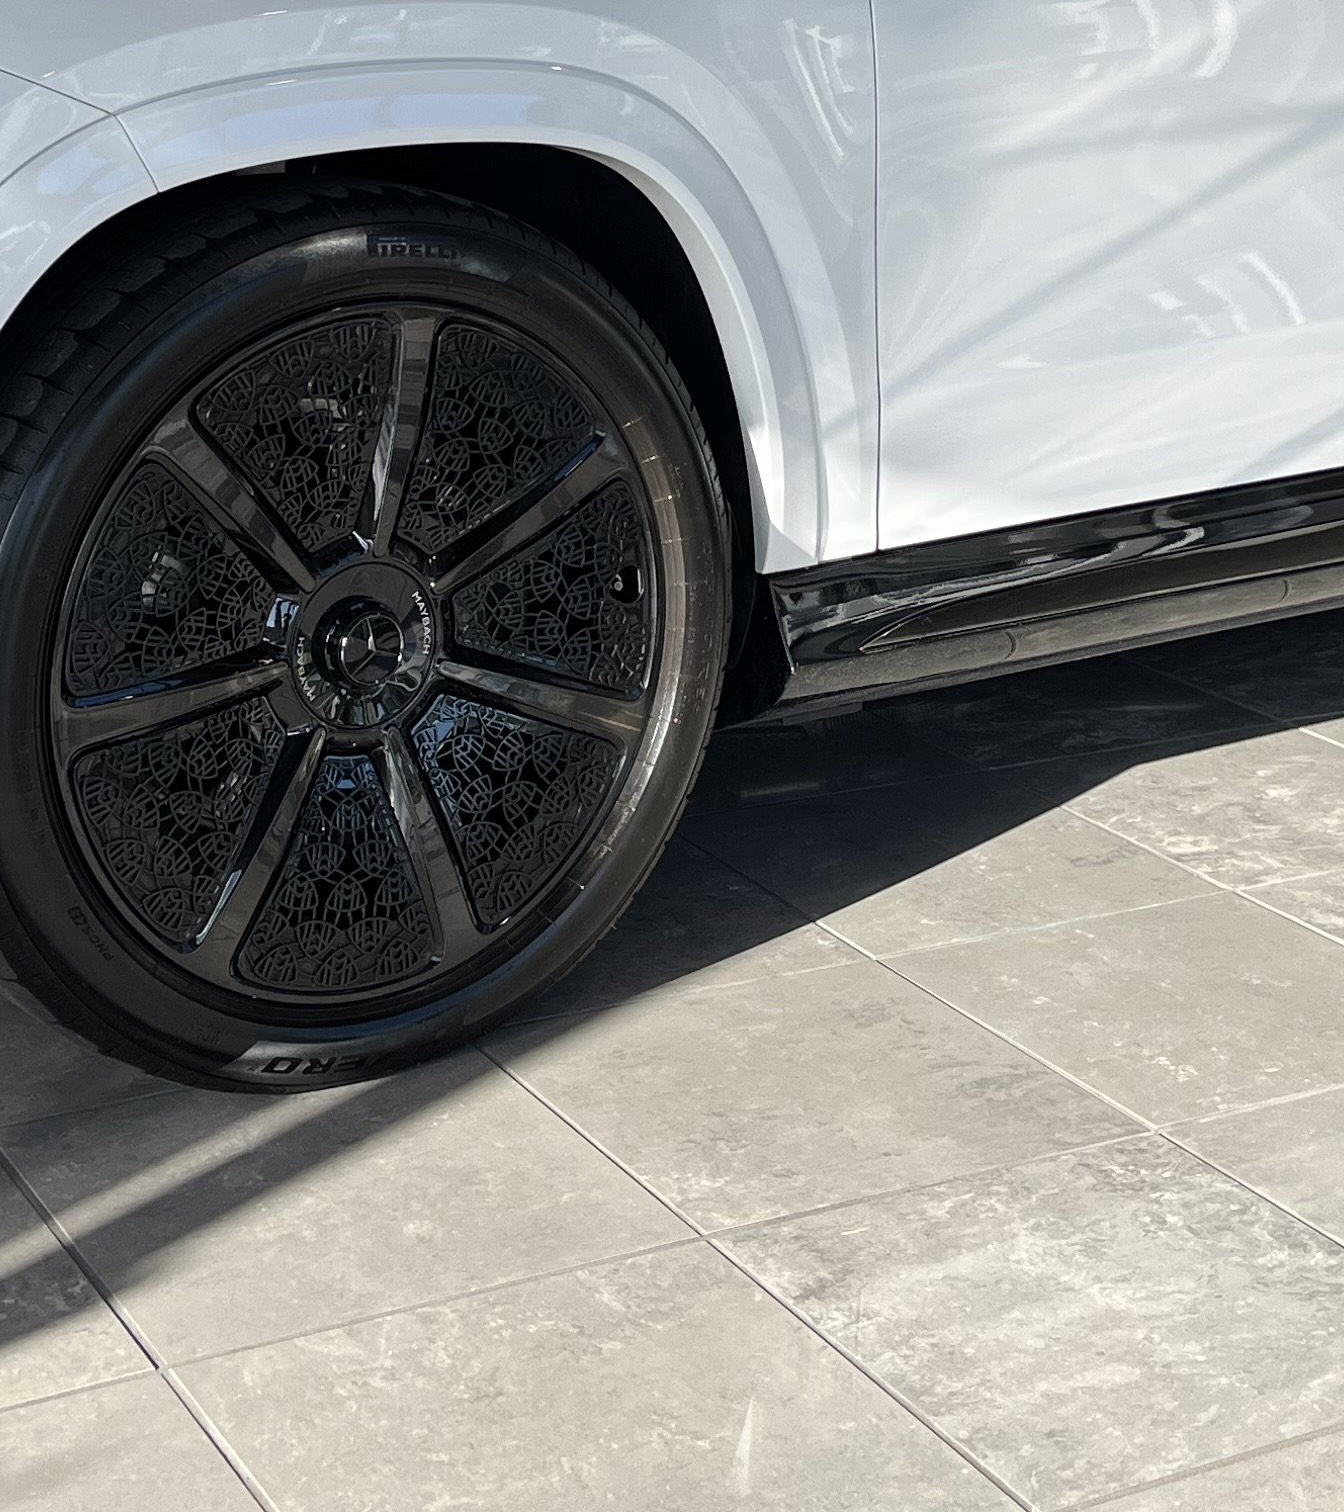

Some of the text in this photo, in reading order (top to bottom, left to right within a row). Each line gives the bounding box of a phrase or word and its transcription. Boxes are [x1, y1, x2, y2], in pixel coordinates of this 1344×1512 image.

[367, 235, 456, 259] PIRELLI
[411, 590, 431, 655] MAYBACH
[296, 637, 317, 701] MAYBACH
[262, 1056, 380, 1075] ERO
